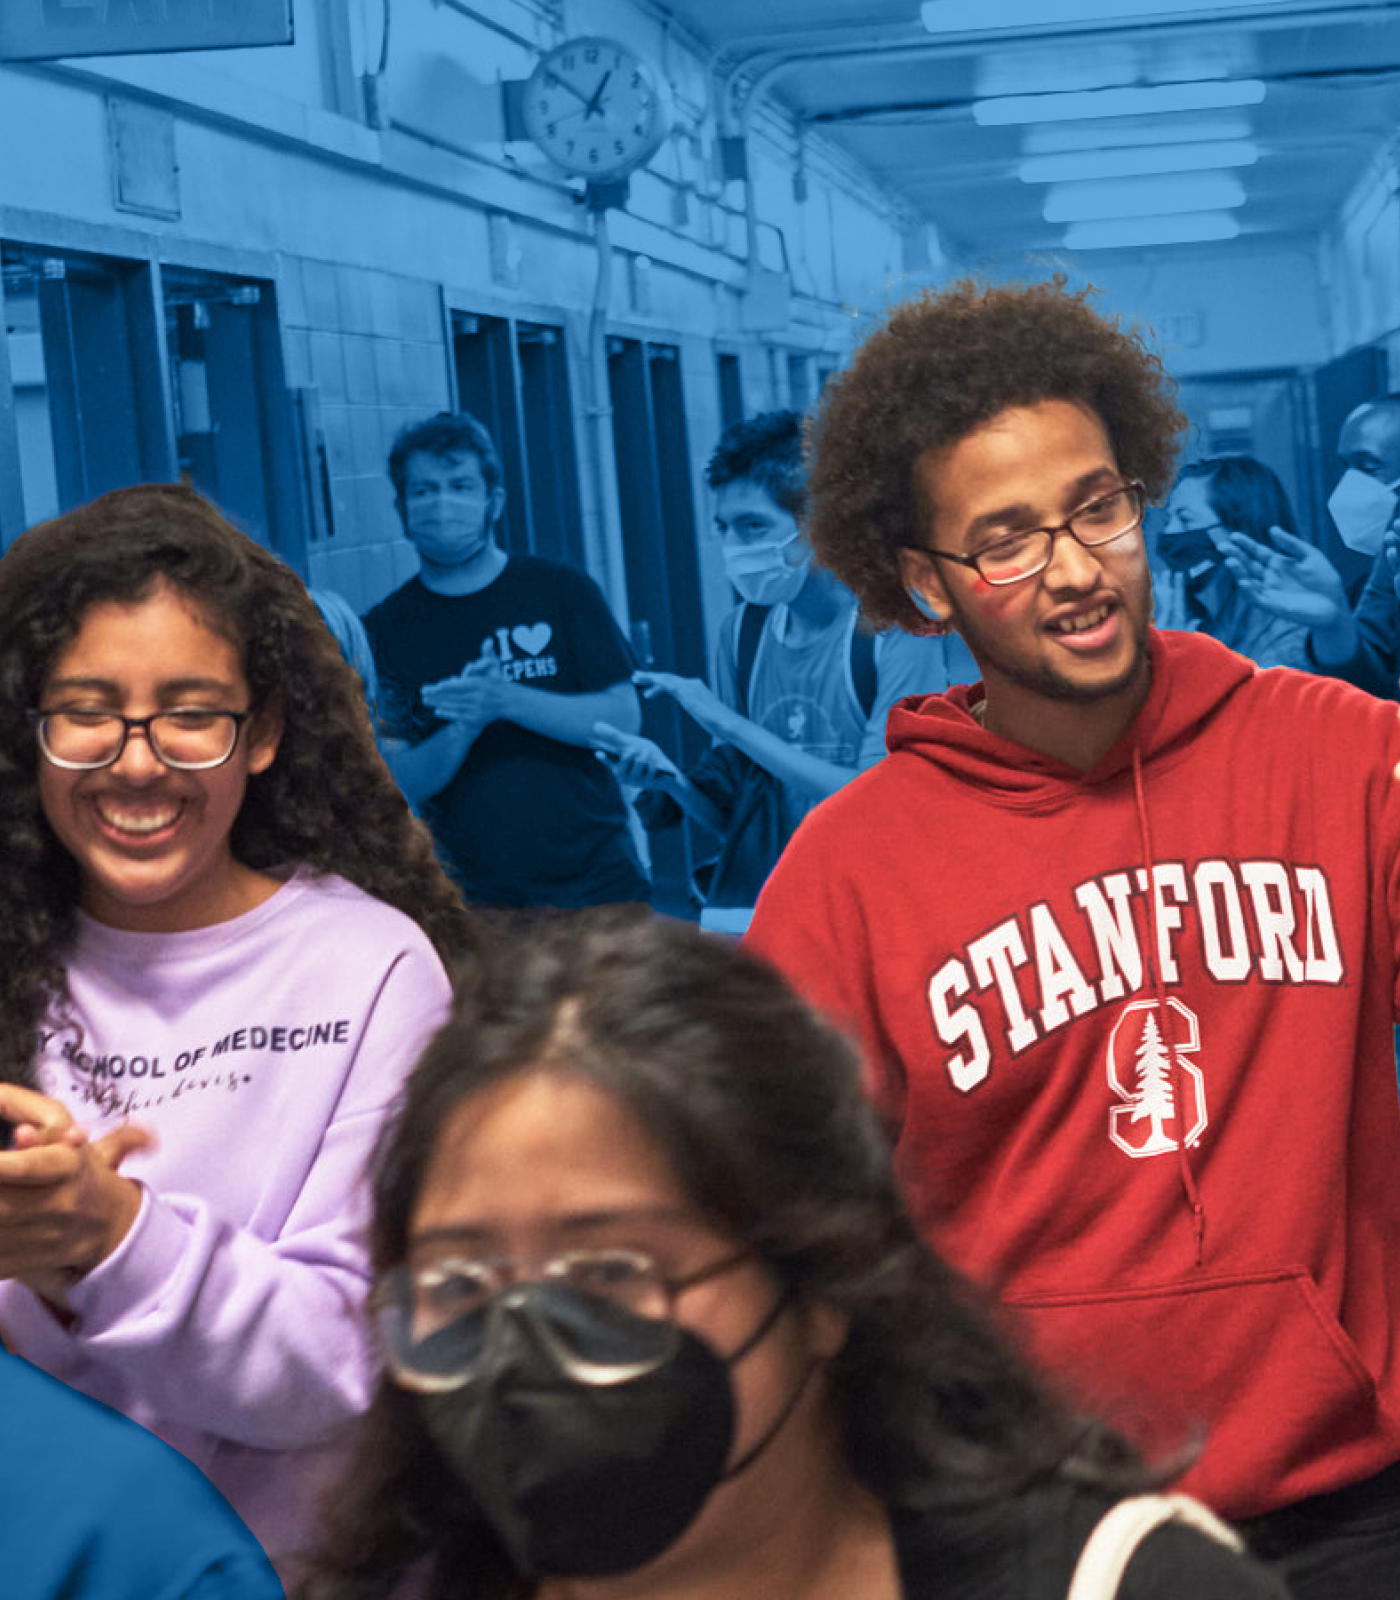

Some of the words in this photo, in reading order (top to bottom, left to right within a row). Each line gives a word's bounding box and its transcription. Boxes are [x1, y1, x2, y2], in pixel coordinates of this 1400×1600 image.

[562, 54, 575, 71] 11
[585, 49, 599, 65] 12
[495, 626, 513, 661] I
[927, 857, 1346, 1095] STANFORD
[174, 1046, 207, 1072] OF
[211, 1020, 351, 1059] MEDECINE
